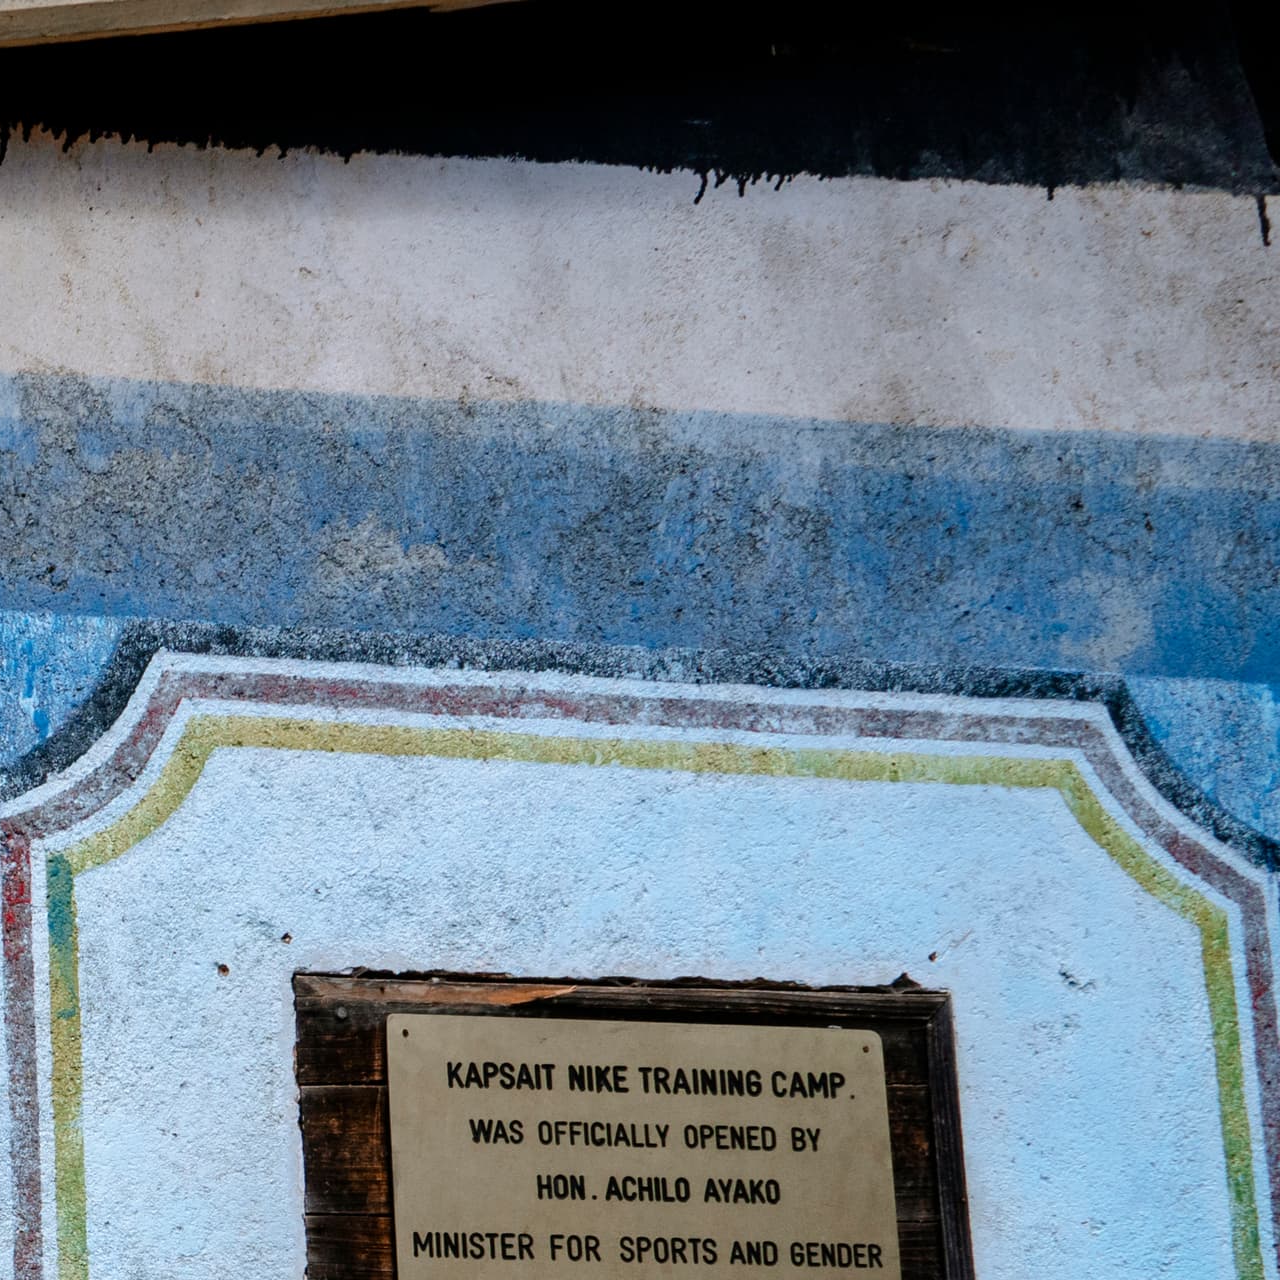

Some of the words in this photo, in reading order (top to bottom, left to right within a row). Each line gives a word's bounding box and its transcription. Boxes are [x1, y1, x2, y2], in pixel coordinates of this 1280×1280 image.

[446, 1061, 556, 1091] KAPSAIT
[567, 1064, 630, 1094] NIKE
[637, 1066, 763, 1098] TRAINING
[468, 1118, 524, 1145] WAS
[537, 1120, 670, 1148] OFFICIALLY
[683, 1124, 777, 1152] OPENED
[790, 1126, 821, 1152] BY
[605, 1175, 691, 1203] ACHILO
[703, 1178, 781, 1205] AYAKO
[412, 1231, 535, 1261] MINISTER
[549, 1234, 602, 1262] FOR
[619, 1236, 718, 1265] SPORTS
[729, 1240, 779, 1267] AND
[790, 1241, 884, 1269] GENDER
